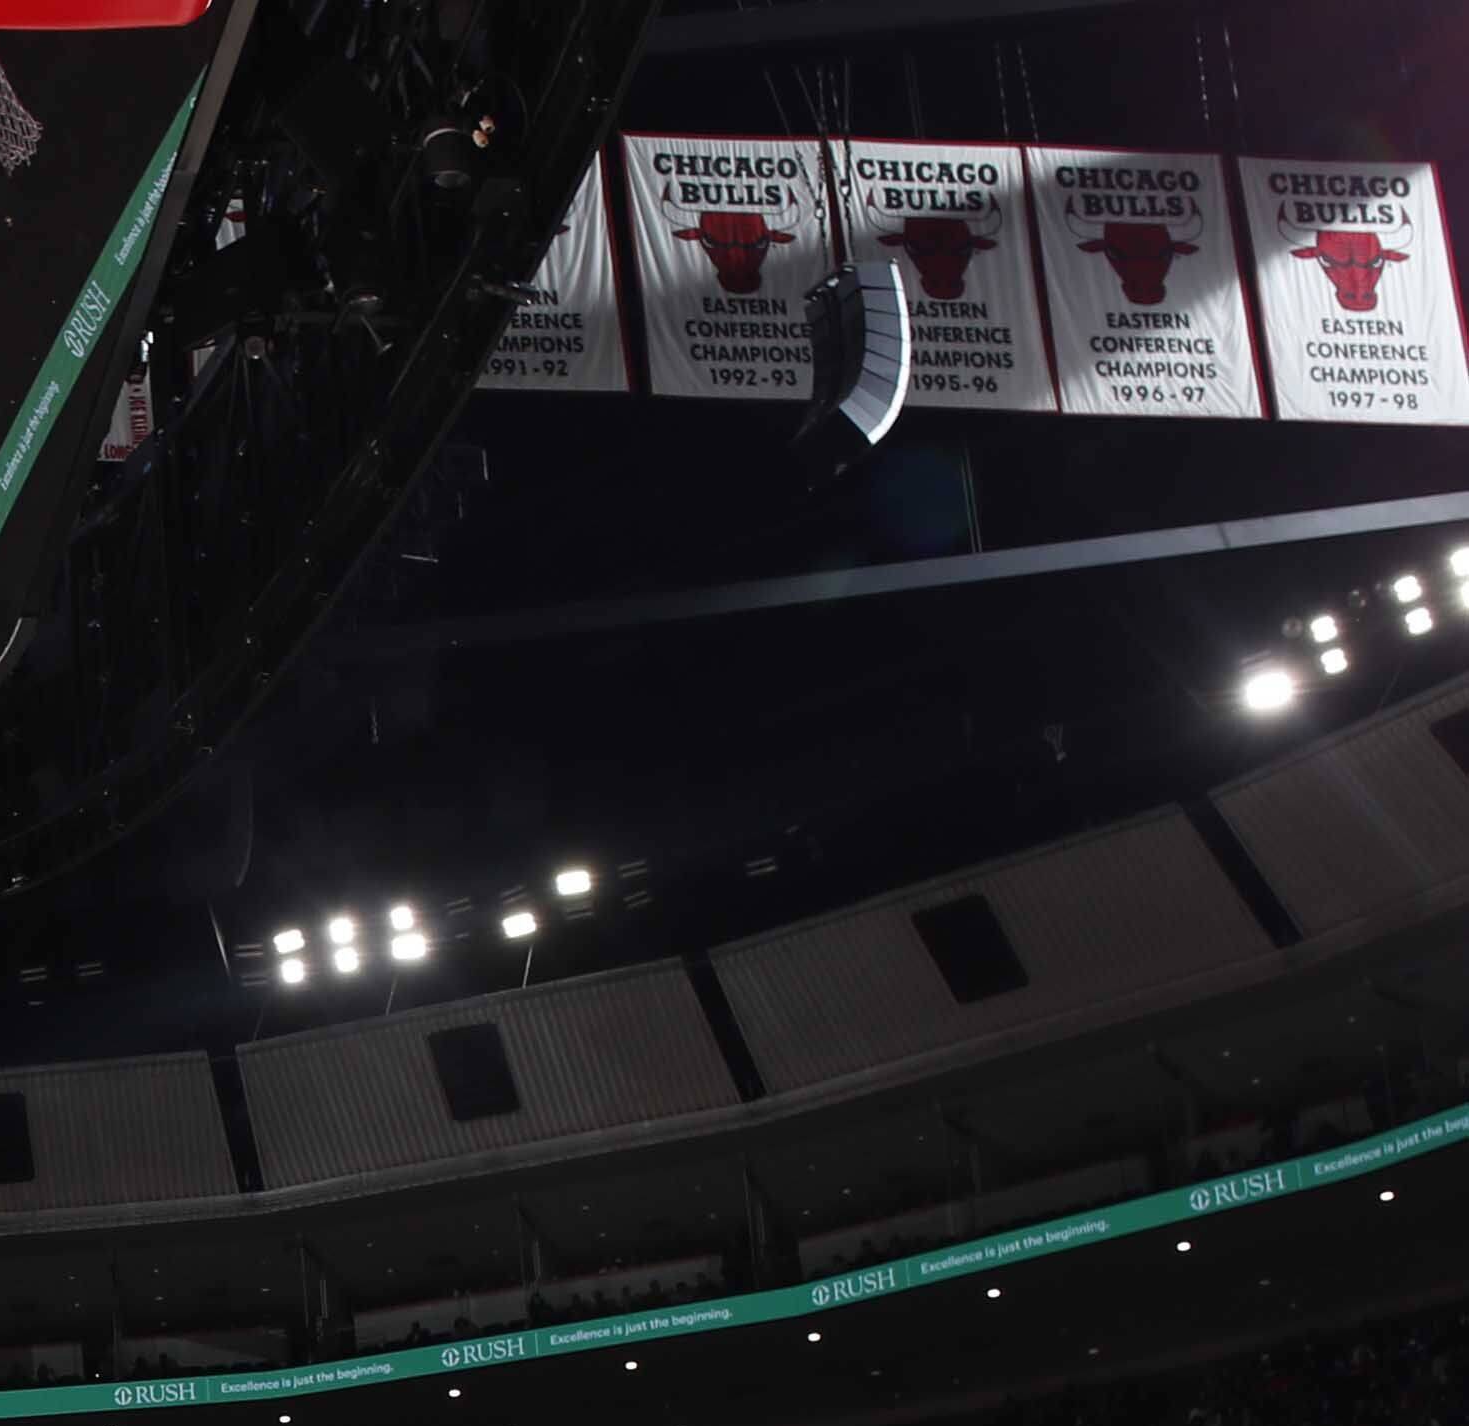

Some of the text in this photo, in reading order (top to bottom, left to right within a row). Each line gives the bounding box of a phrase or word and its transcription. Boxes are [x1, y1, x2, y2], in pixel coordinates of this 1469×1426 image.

[654, 153, 798, 178] CHICAGO
[681, 182, 781, 205] BULLS
[1270, 172, 1410, 197] CHICAGO
[1295, 202, 1395, 225] BULLS
[74, 280, 110, 344] RUSH
[703, 297, 787, 315] EASTERN
[685, 320, 812, 339] CONFERENCE
[1322, 319, 1403, 336] EASTERN
[690, 343, 811, 363] CHAMPIONS
[1306, 342, 1429, 361] CONFERENCE
[1310, 366, 1429, 385] CHAMPIONS
[832, 1267, 896, 1304] RUSH
[135, 1382, 195, 1404] RUSH
